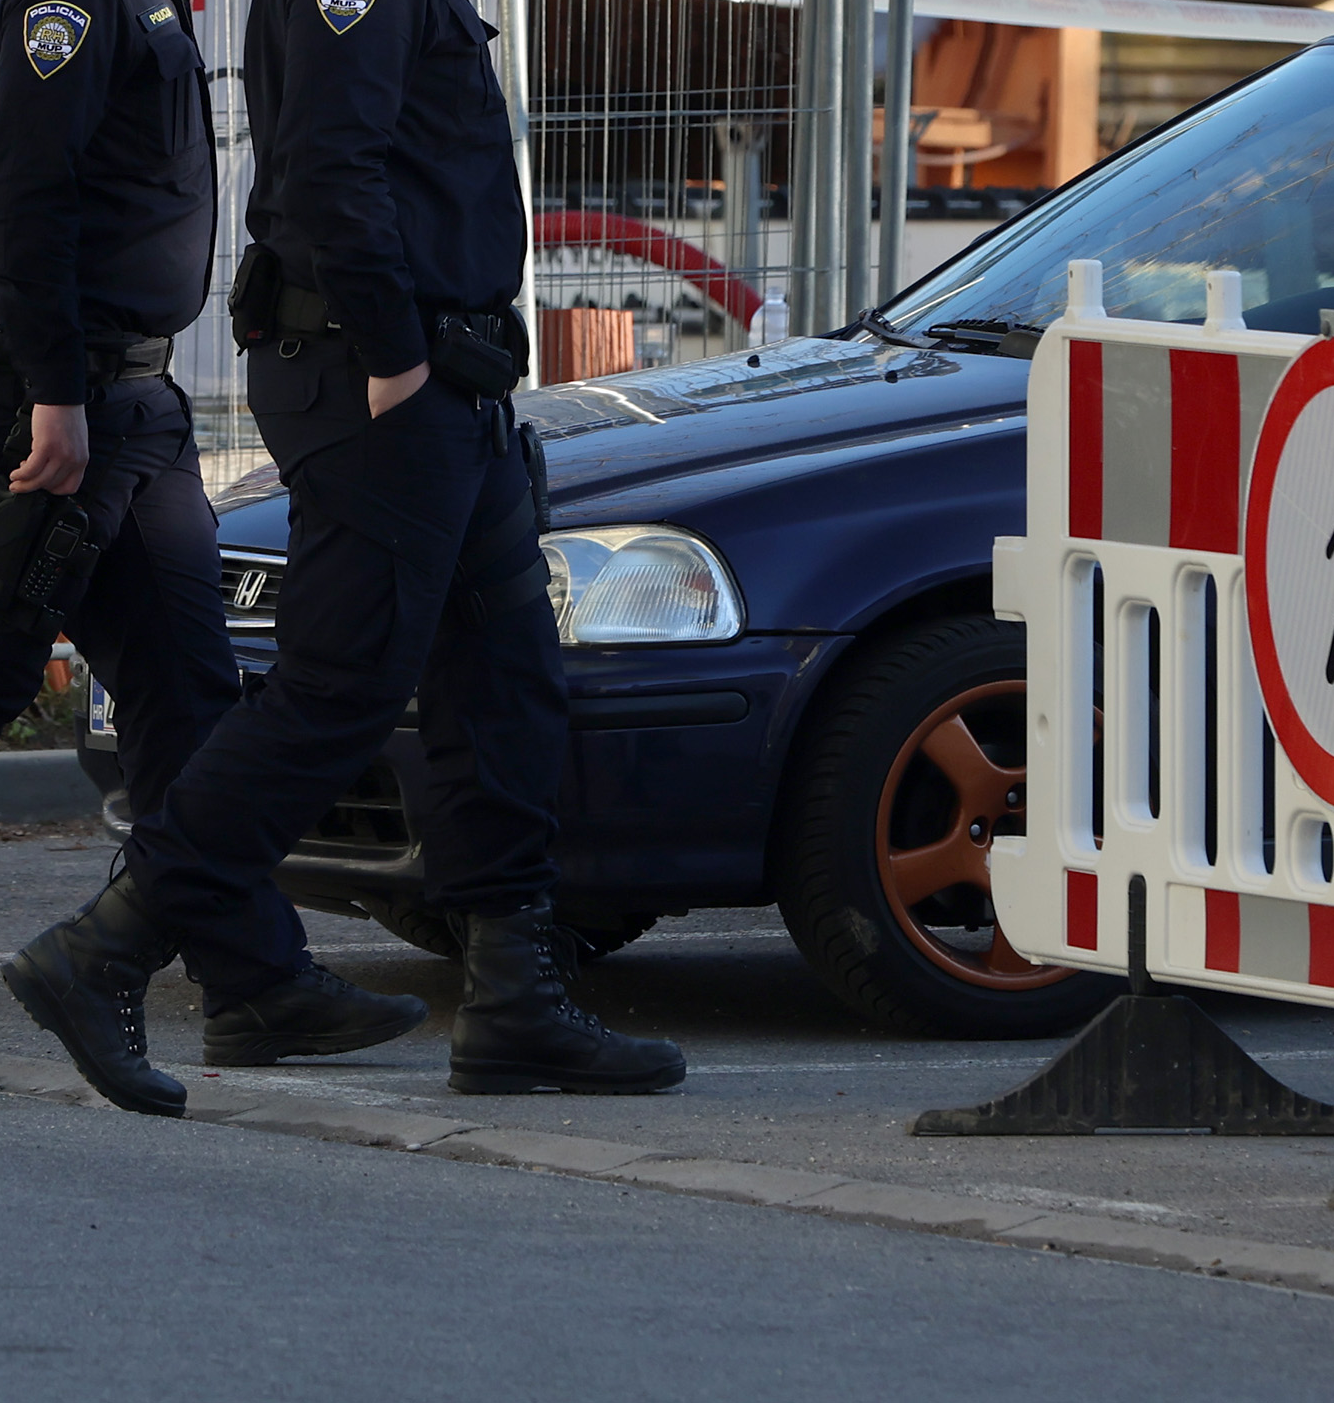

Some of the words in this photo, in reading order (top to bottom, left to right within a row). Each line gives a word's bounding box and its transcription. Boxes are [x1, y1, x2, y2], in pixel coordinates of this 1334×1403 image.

[29, 5, 86, 28] POLICIJA
[40, 28, 65, 43] RH
[36, 41, 64, 53] MUP
[92, 703, 104, 721] HR
